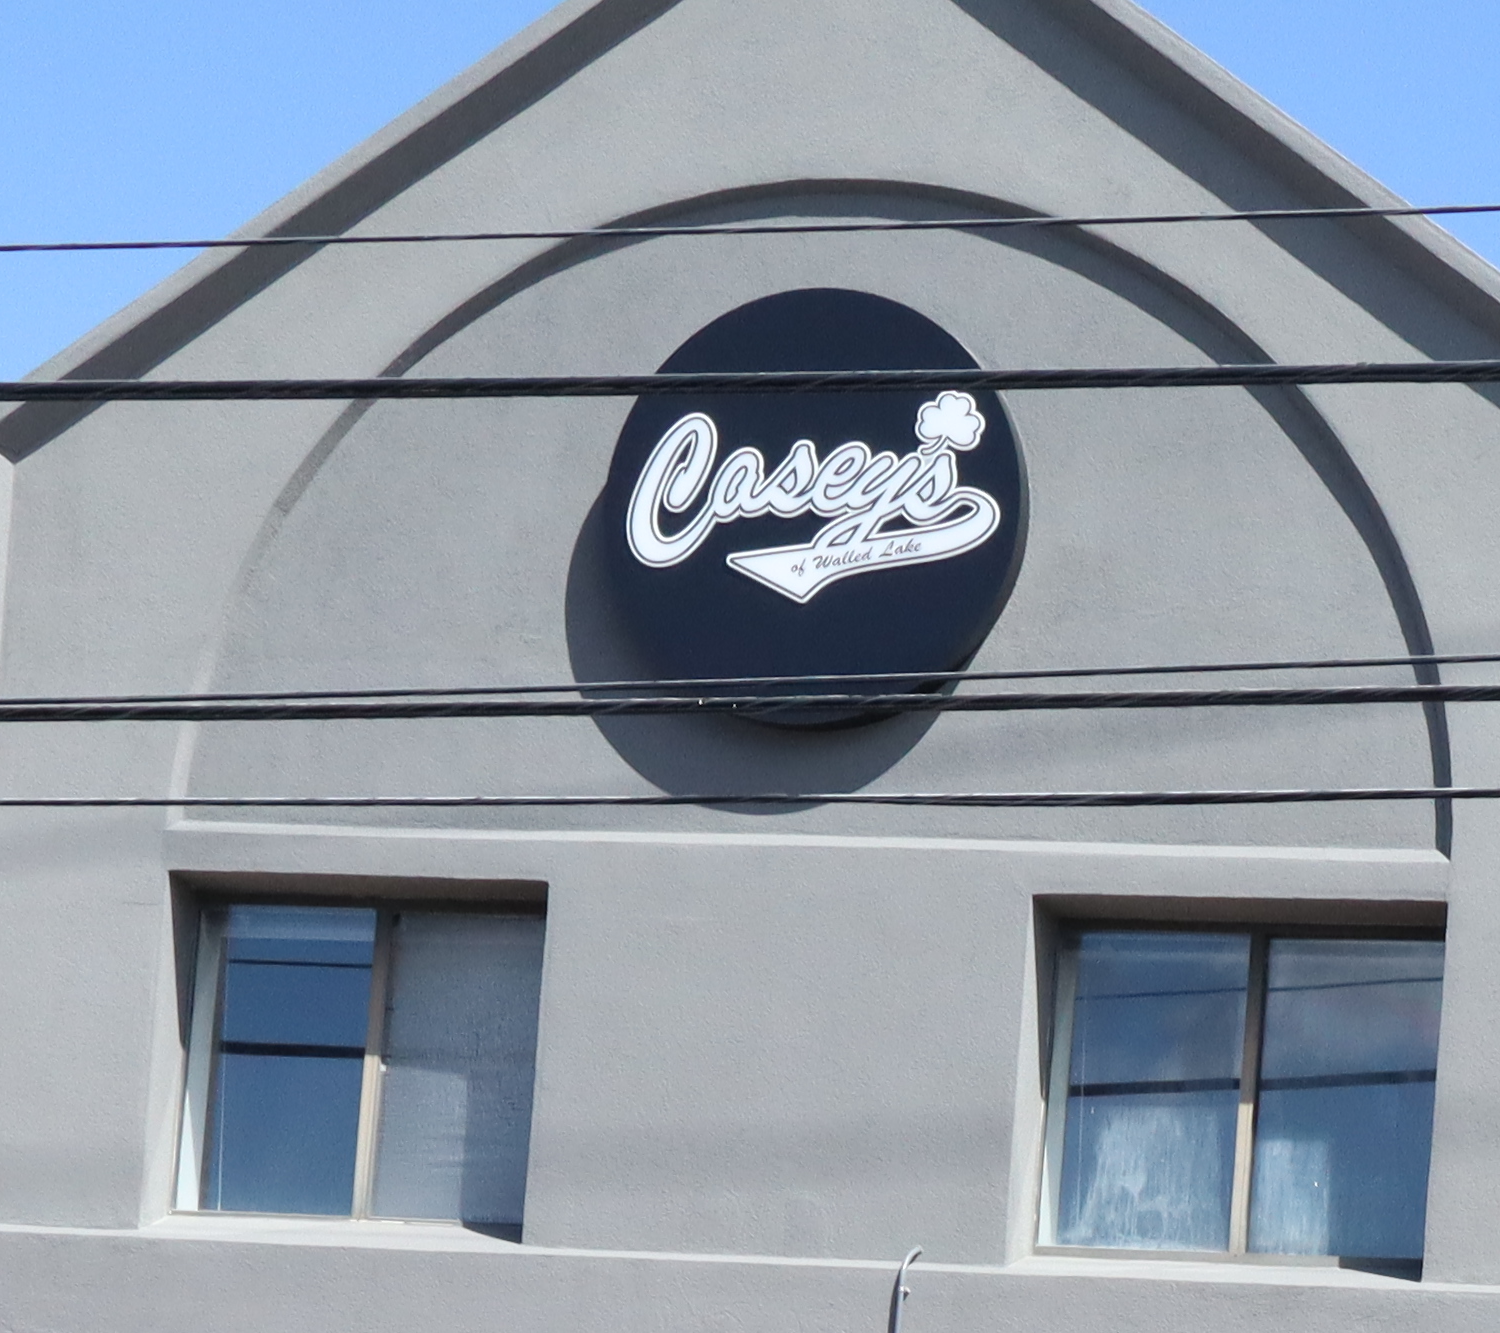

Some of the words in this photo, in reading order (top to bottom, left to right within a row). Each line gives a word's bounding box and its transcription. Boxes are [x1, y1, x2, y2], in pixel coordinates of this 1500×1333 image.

[790, 559, 807, 576] of
[812, 545, 873, 570] Walled
[878, 538, 922, 560] Lake
